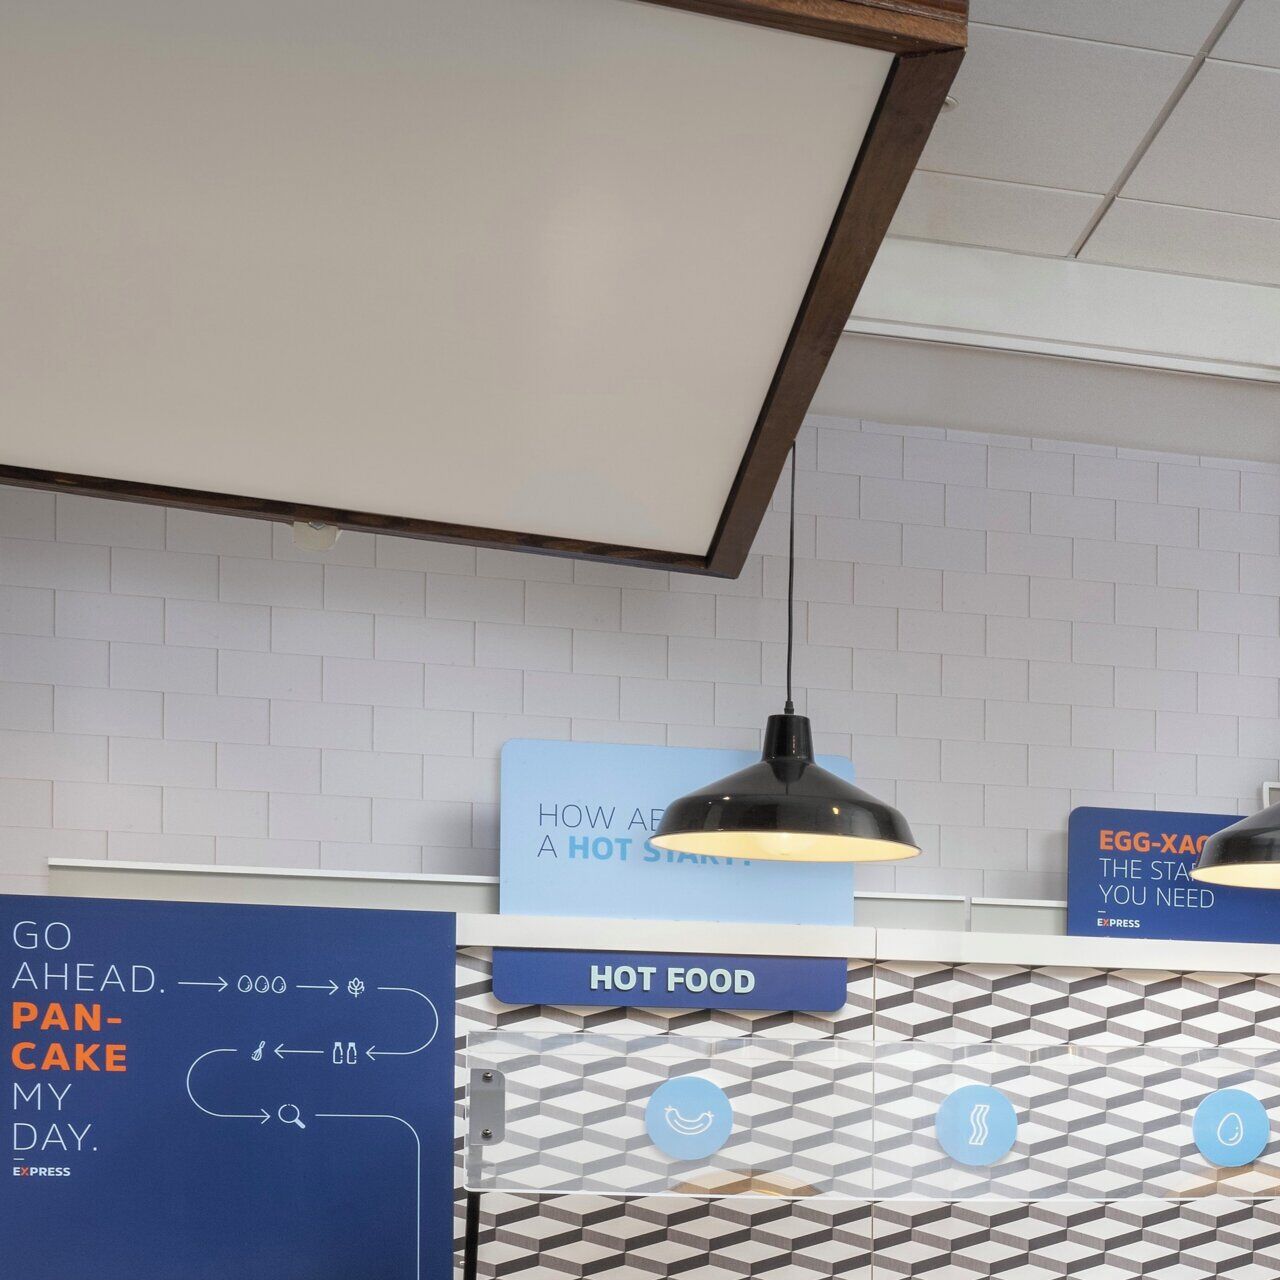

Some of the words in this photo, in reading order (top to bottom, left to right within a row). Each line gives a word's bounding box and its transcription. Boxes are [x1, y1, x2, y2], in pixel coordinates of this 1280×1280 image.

[539, 803, 616, 830] HOW
[536, 834, 558, 858] A
[568, 835, 633, 862] HOT
[1098, 857, 1143, 879] THE
[1151, 860, 1200, 882] STA
[1098, 884, 1147, 906] YOU
[1156, 887, 1216, 909] NEED
[12, 920, 72, 951] GO
[1096, 917, 1141, 929] EXPRESS
[11, 961, 166, 994] AHEAD.
[589, 965, 657, 992] HOT
[667, 966, 757, 995] FOOD
[11, 1002, 123, 1031] PAN-
[11, 1042, 128, 1073] CAKE
[12, 1082, 72, 1111] MY
[12, 1122, 99, 1152] DAY.
[12, 1165, 72, 1178] EXPRESS
